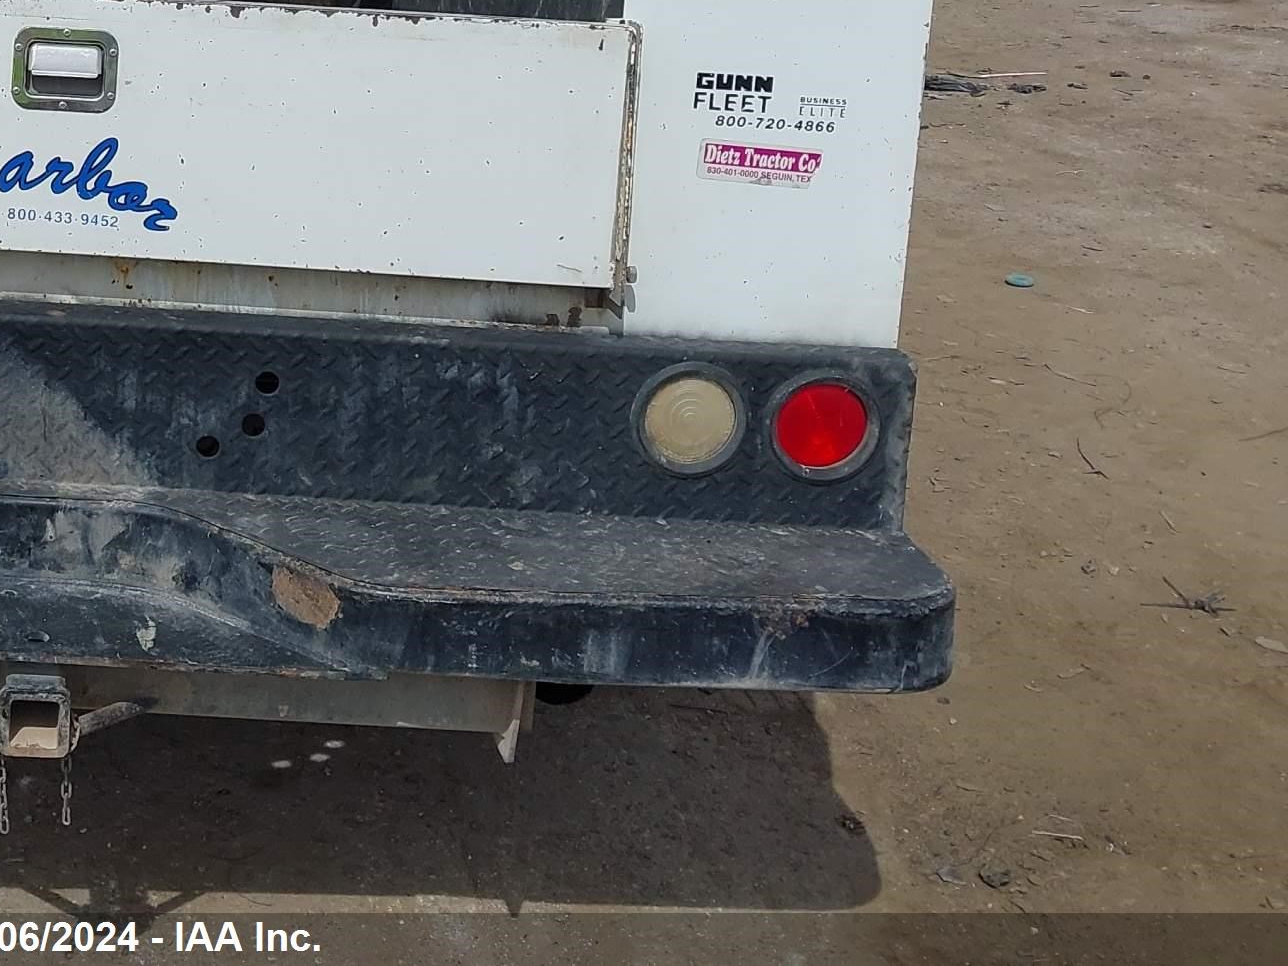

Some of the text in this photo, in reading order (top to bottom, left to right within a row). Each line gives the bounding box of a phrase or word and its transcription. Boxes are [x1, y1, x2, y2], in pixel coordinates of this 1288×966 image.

[696, 72, 774, 93] GUNN
[693, 92, 772, 114] FLEET
[800, 96, 847, 106] BUSINESS
[799, 106, 846, 119] ELITE
[715, 115, 836, 133] 800-720-4866
[704, 144, 741, 165] Dietz
[744, 148, 796, 171] Tractor
[706, 166, 759, 179] 830-401-0000
